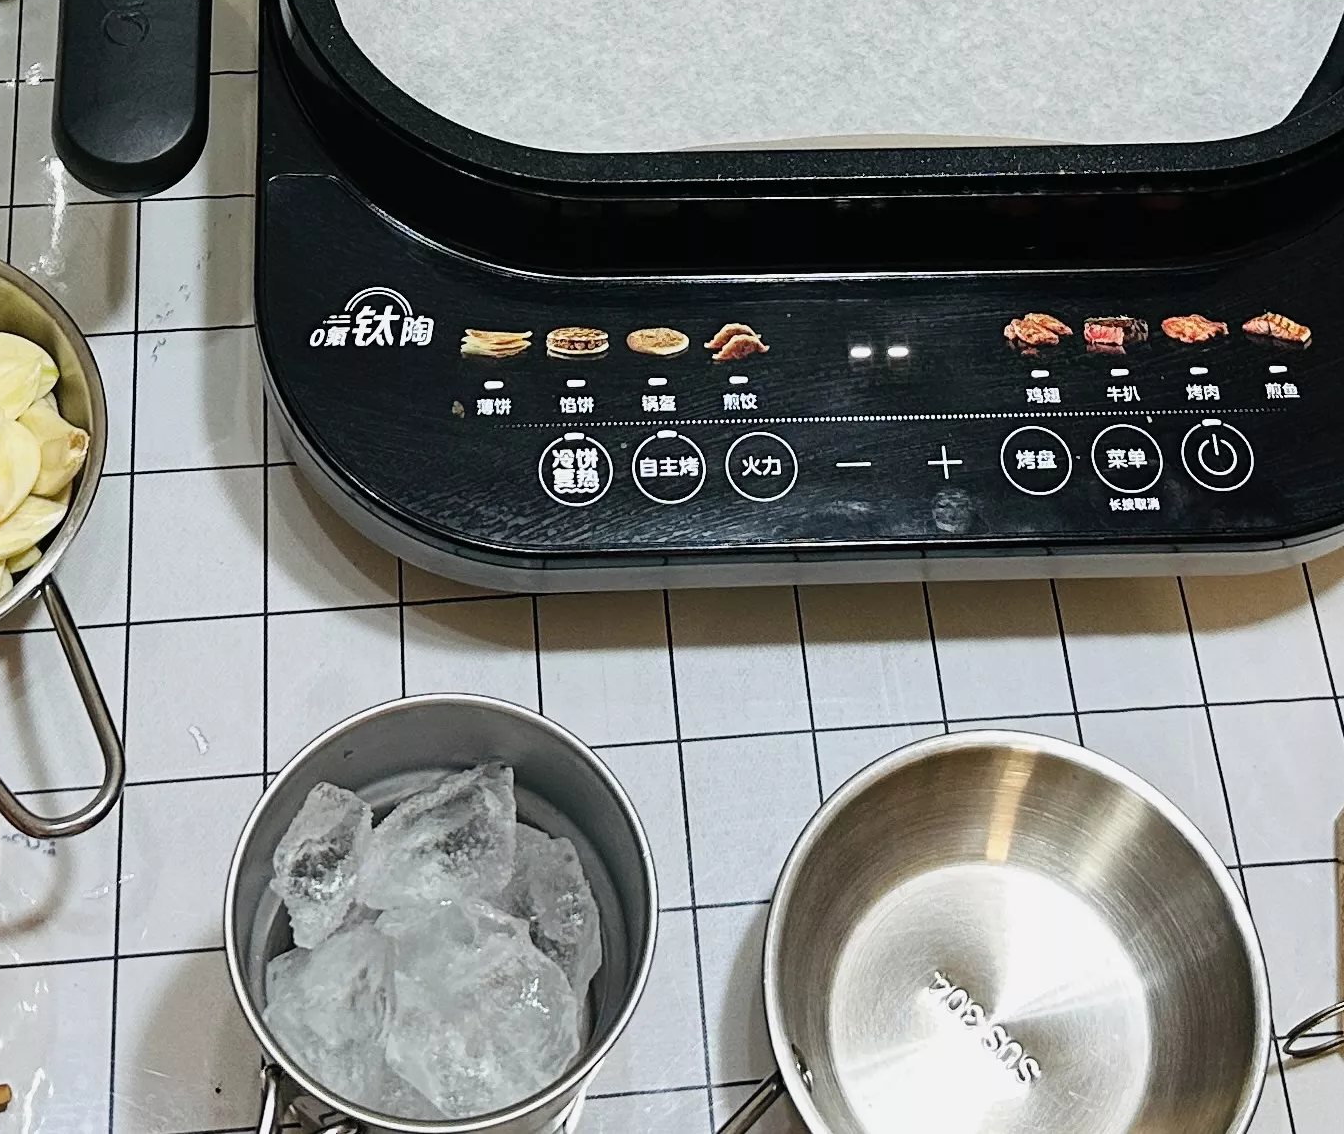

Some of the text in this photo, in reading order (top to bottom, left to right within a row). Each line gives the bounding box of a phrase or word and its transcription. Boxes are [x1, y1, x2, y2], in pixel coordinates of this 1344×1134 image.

[1025, 386, 1062, 404] 鸡翅
[1106, 385, 1141, 403] 牛扒
[1185, 383, 1221, 401] 烤肉
[1264, 381, 1301, 400] 煎鱼
[476, 397, 512, 416] 薄饼
[559, 396, 595, 414] 馅饼
[641, 394, 677, 413] 锅盔
[722, 392, 759, 411] 煎饺
[552, 448, 599, 468] 冷饼
[639, 456, 700, 478] 自主烤
[741, 455, 782, 477] 火力
[1015, 449, 1058, 470] 烤盘
[1105, 447, 1148, 469] 菜单
[552, 467, 600, 489] 复热
[1108, 496, 1161, 512] 长按取消
[928, 970, 1042, 1085] SUS 304
